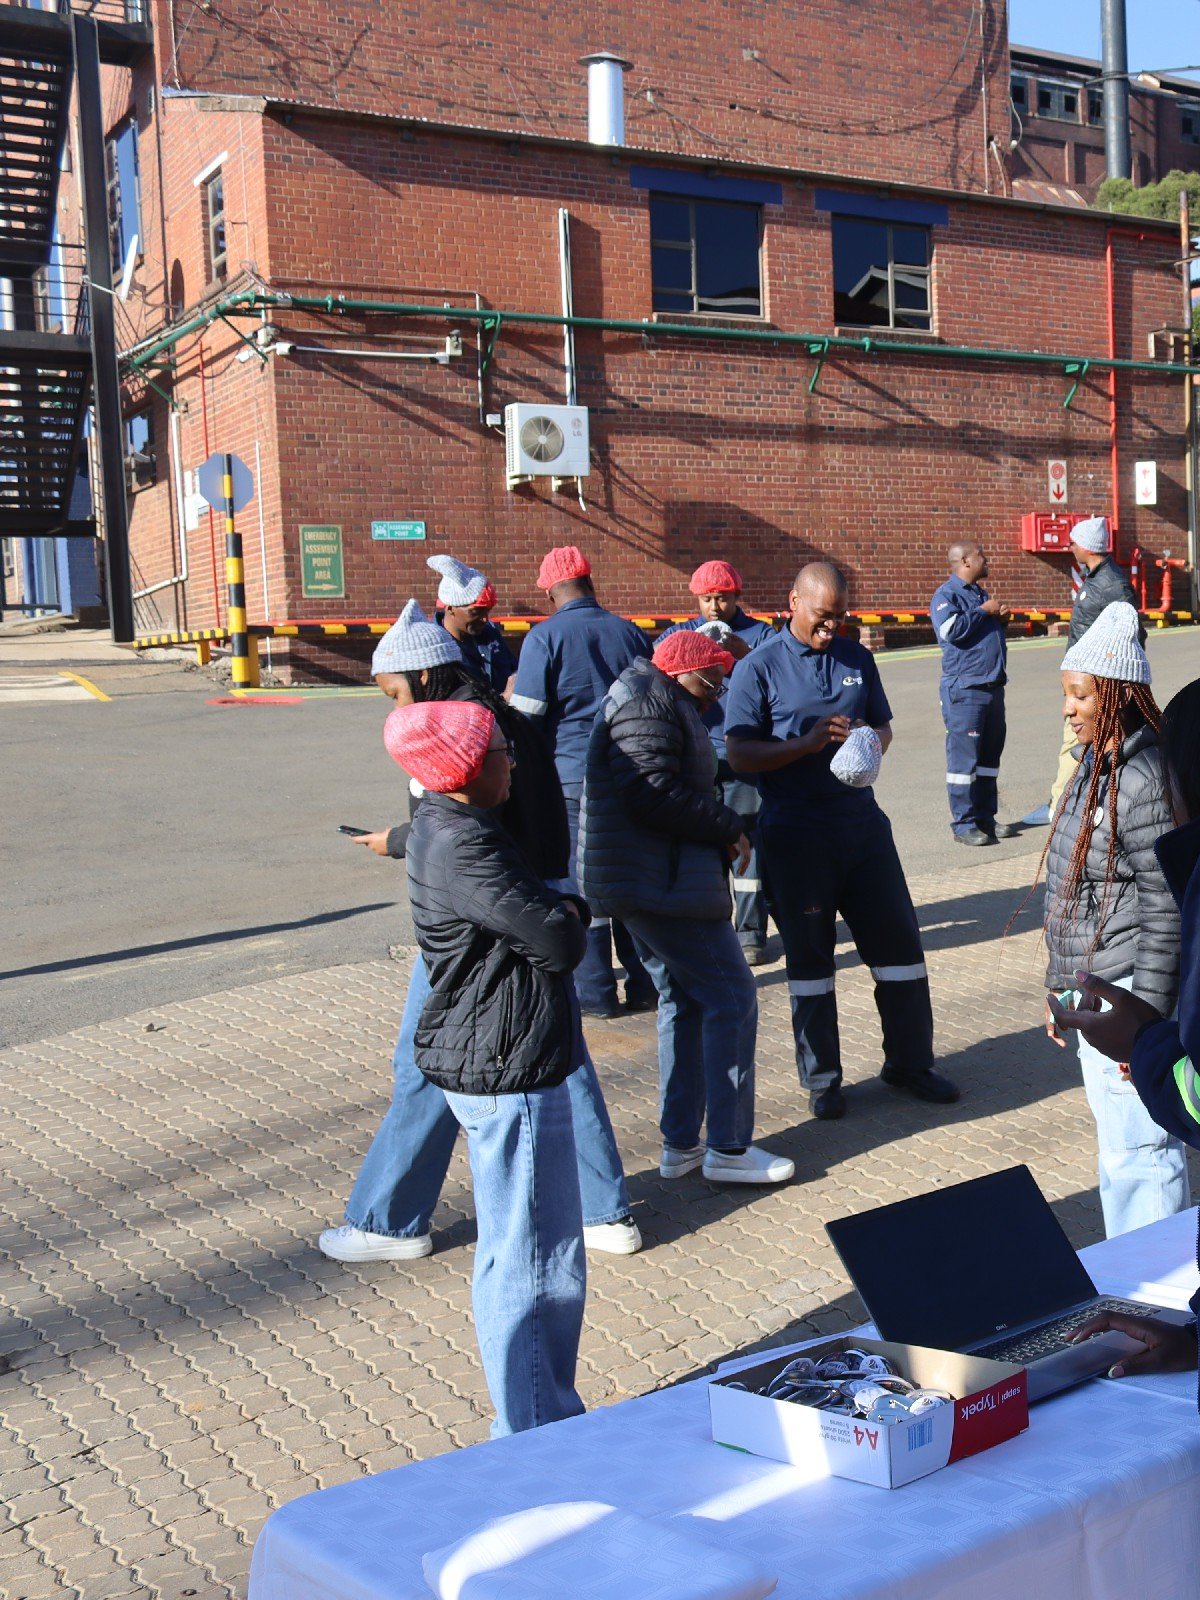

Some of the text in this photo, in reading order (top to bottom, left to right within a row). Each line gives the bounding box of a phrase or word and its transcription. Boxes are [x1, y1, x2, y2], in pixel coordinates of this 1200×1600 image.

[304, 532, 336, 541] EMERGENCY
[305, 544, 338, 554] ASSEMBLY
[312, 557, 332, 567] POINT
[315, 570, 331, 579] AREA
[961, 1386, 1021, 1421] sappi Typek
[853, 1425, 879, 1450] A4
